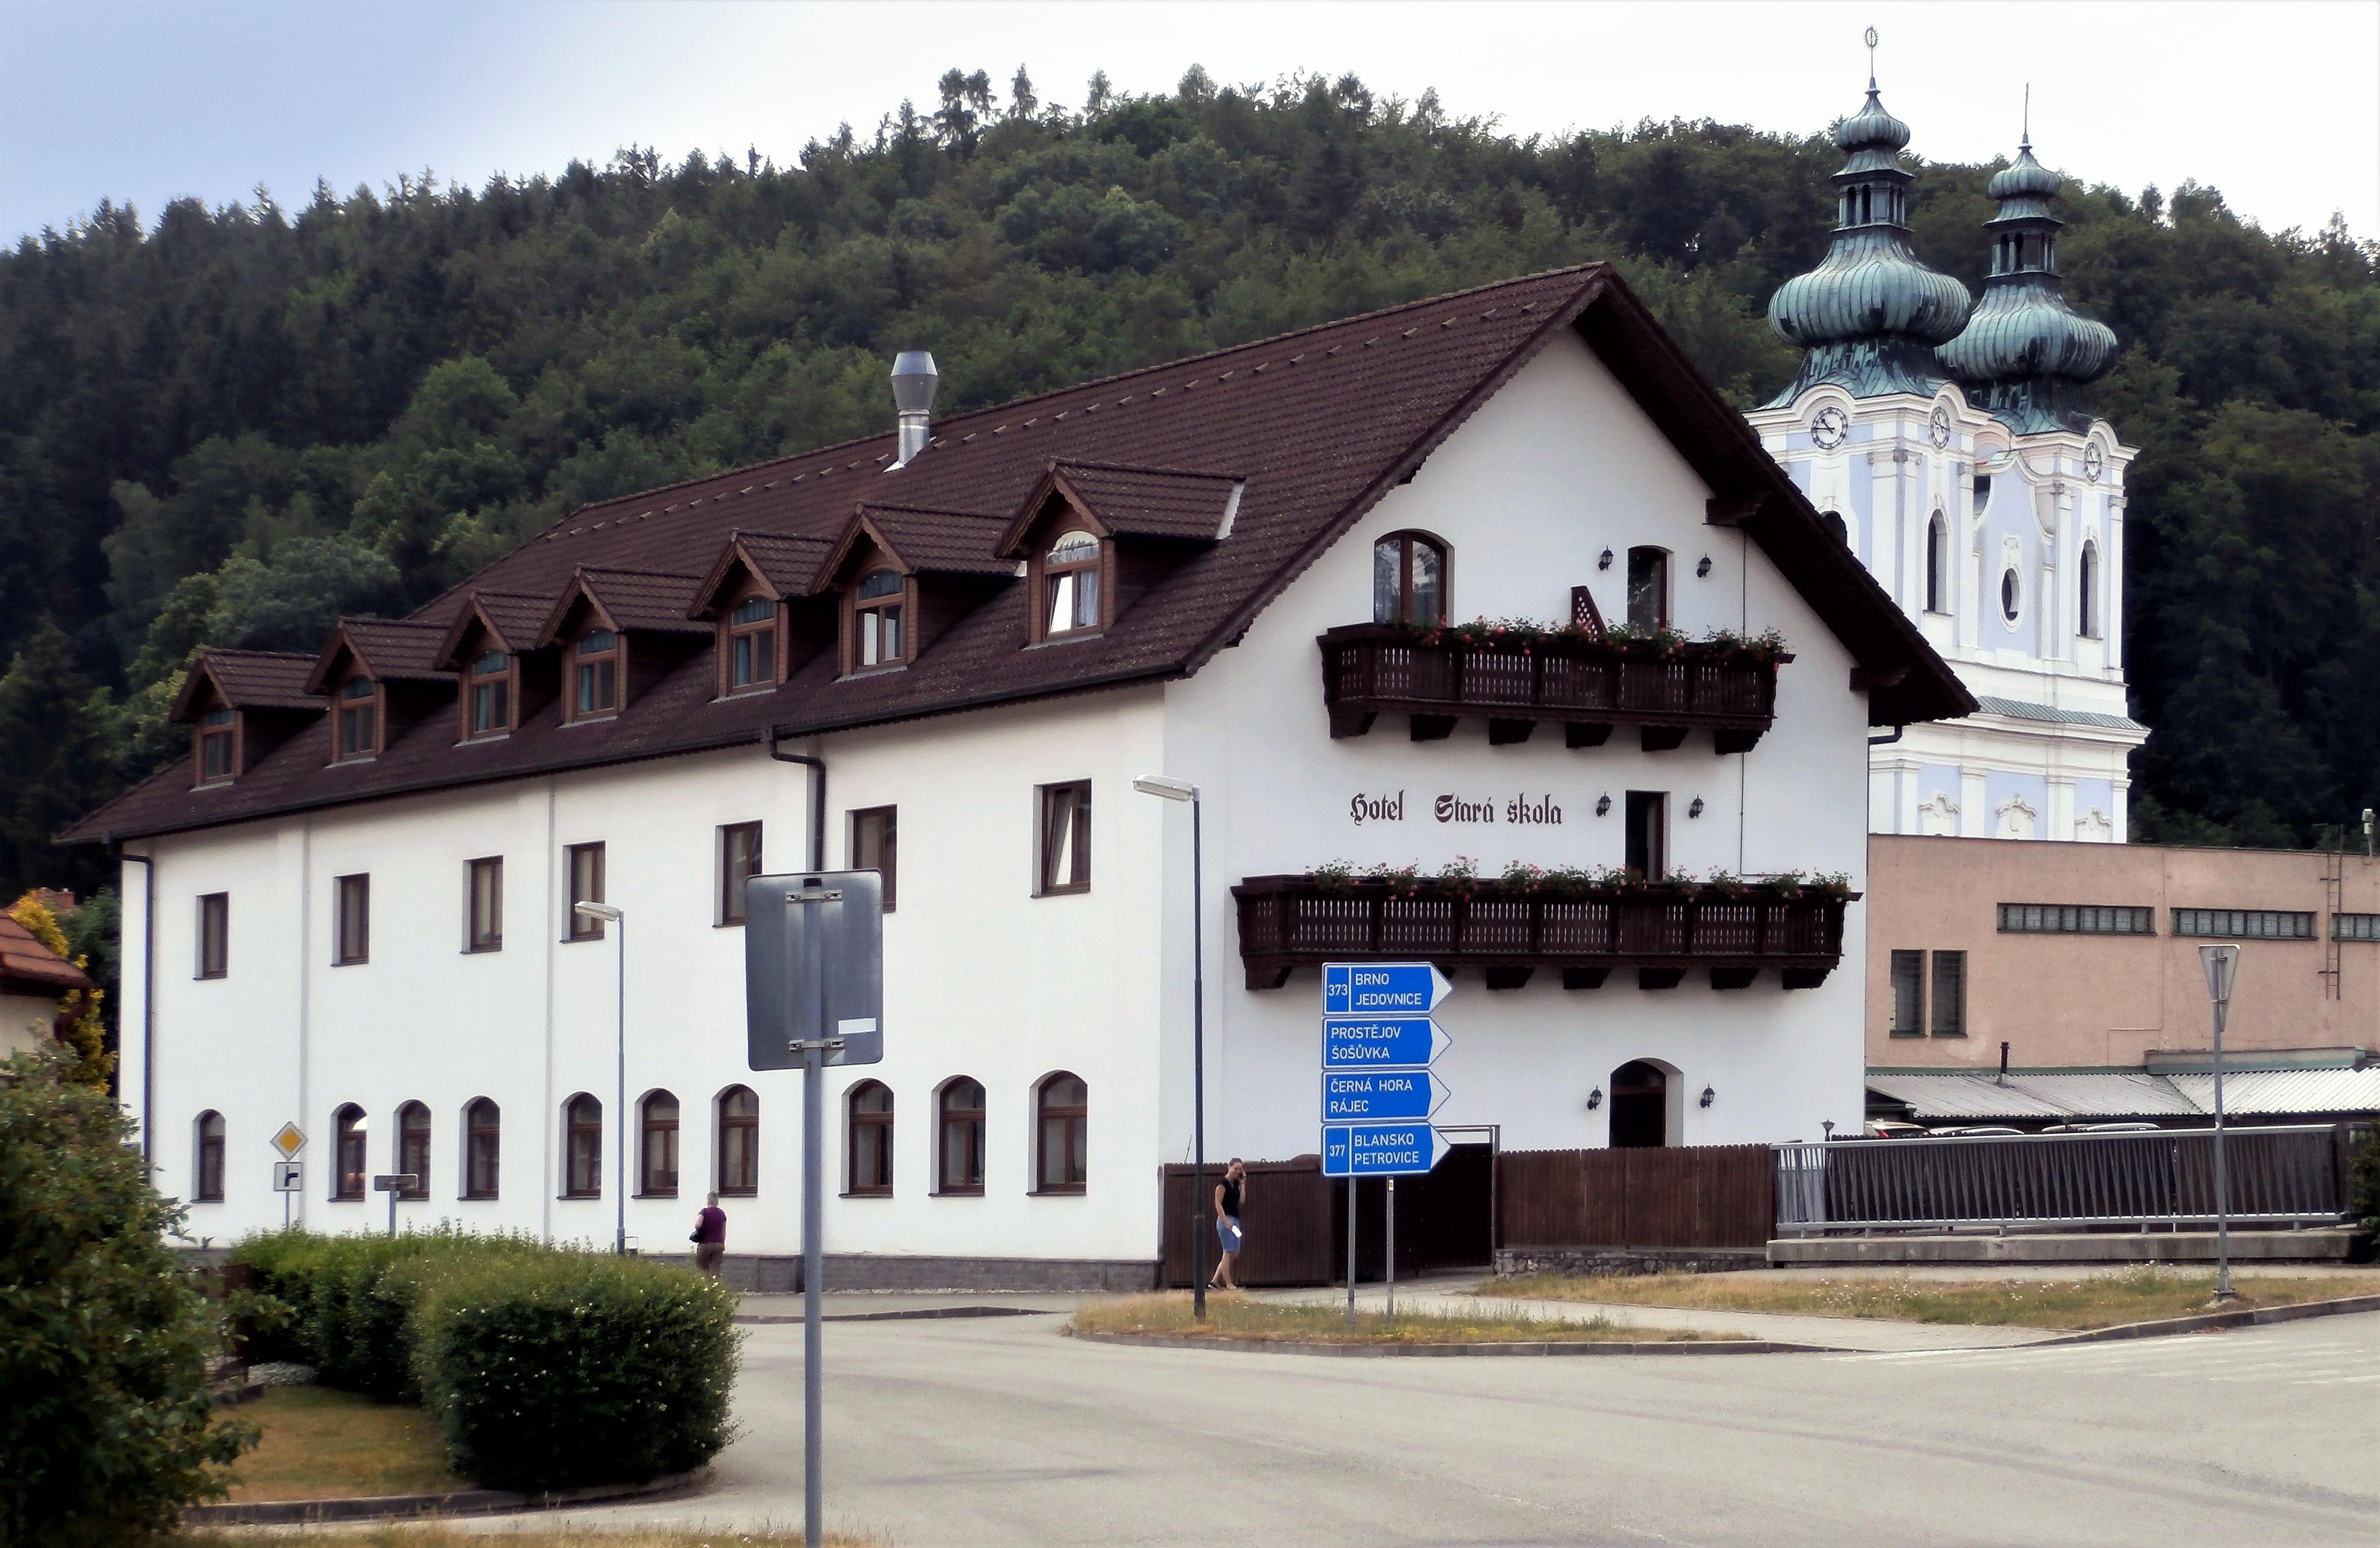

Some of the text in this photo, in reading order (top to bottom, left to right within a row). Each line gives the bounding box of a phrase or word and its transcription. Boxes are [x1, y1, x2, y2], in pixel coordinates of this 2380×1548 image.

[1349, 789, 1562, 826] Hotel Stará škola
[1355, 973, 1389, 986] BRNO
[1328, 984, 1348, 996] 373
[1356, 993, 1422, 1005] JEDOVNICE
[1331, 1024, 1401, 1039] PROSTĚJOV
[1332, 1044, 1390, 1059] ŠOŠŮVKA
[1330, 1077, 1413, 1093] ČERNÁ HORA
[1330, 1097, 1368, 1113] RÁJEC
[1354, 1133, 1414, 1147] BLANSKO
[1329, 1144, 1346, 1156] 377
[1354, 1151, 1419, 1165] PETROVICE
